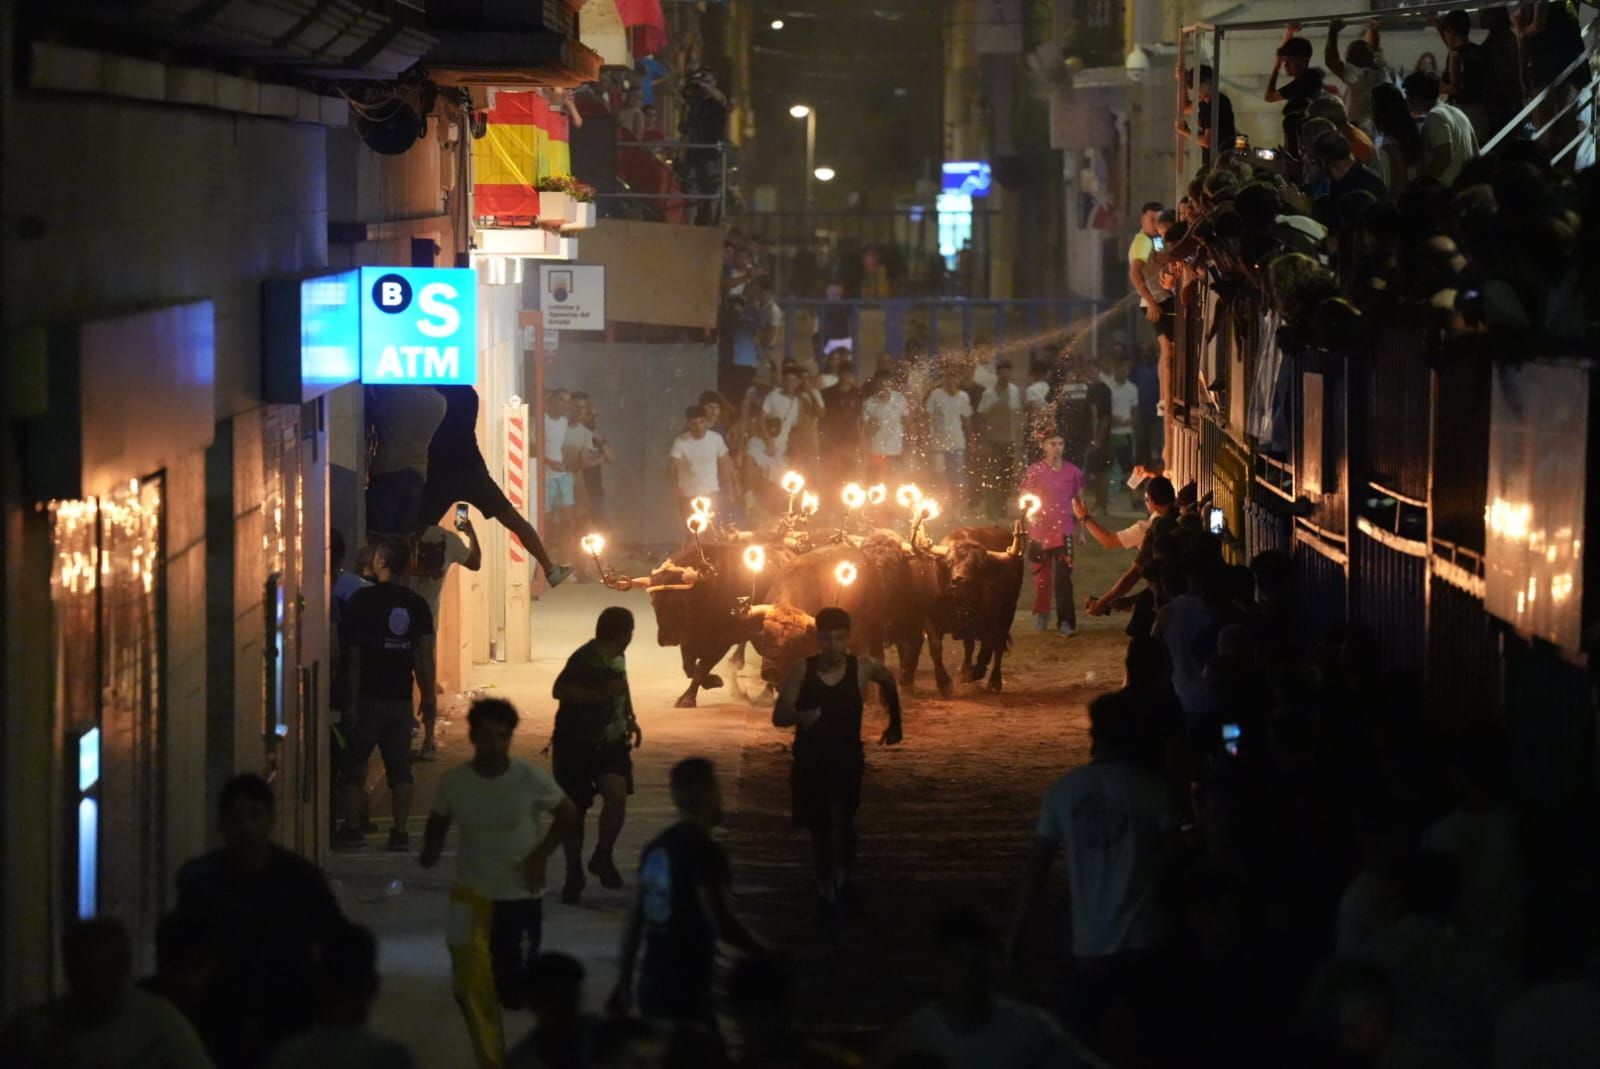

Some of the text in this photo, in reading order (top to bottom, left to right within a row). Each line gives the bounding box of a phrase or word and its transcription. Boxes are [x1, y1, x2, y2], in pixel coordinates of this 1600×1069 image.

[382, 282, 460, 338] B S
[376, 346, 459, 378] ATM
